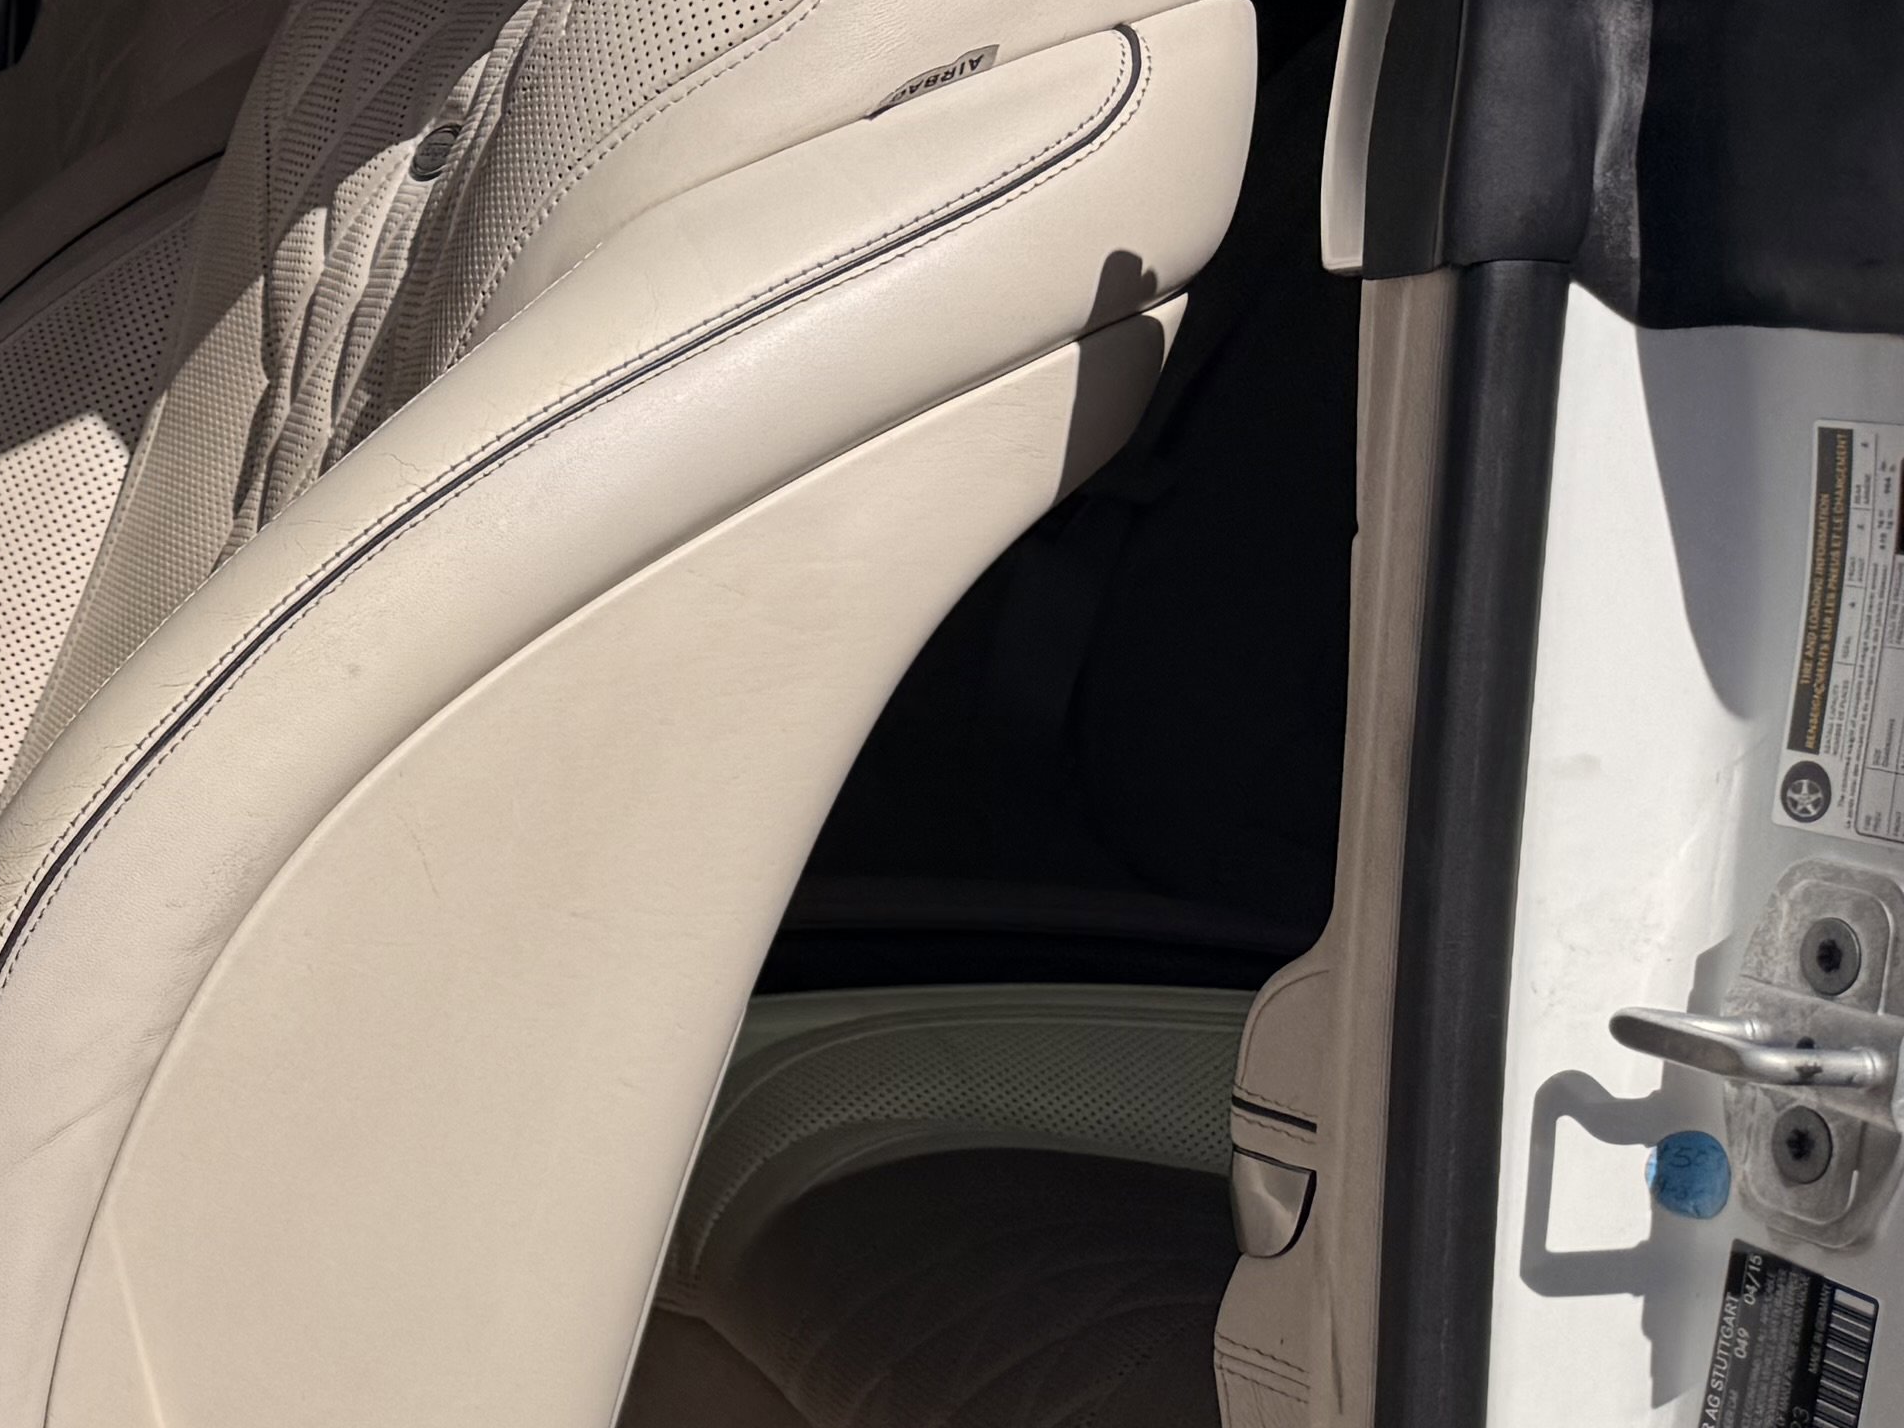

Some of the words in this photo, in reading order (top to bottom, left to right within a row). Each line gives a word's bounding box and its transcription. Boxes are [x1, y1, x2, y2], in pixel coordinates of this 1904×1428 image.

[1807, 575, 1823, 631] LOADING
[1803, 630, 1817, 659] AND
[1709, 1291, 1739, 1392] STUTTGART
[1703, 1393, 1721, 1421] AG
